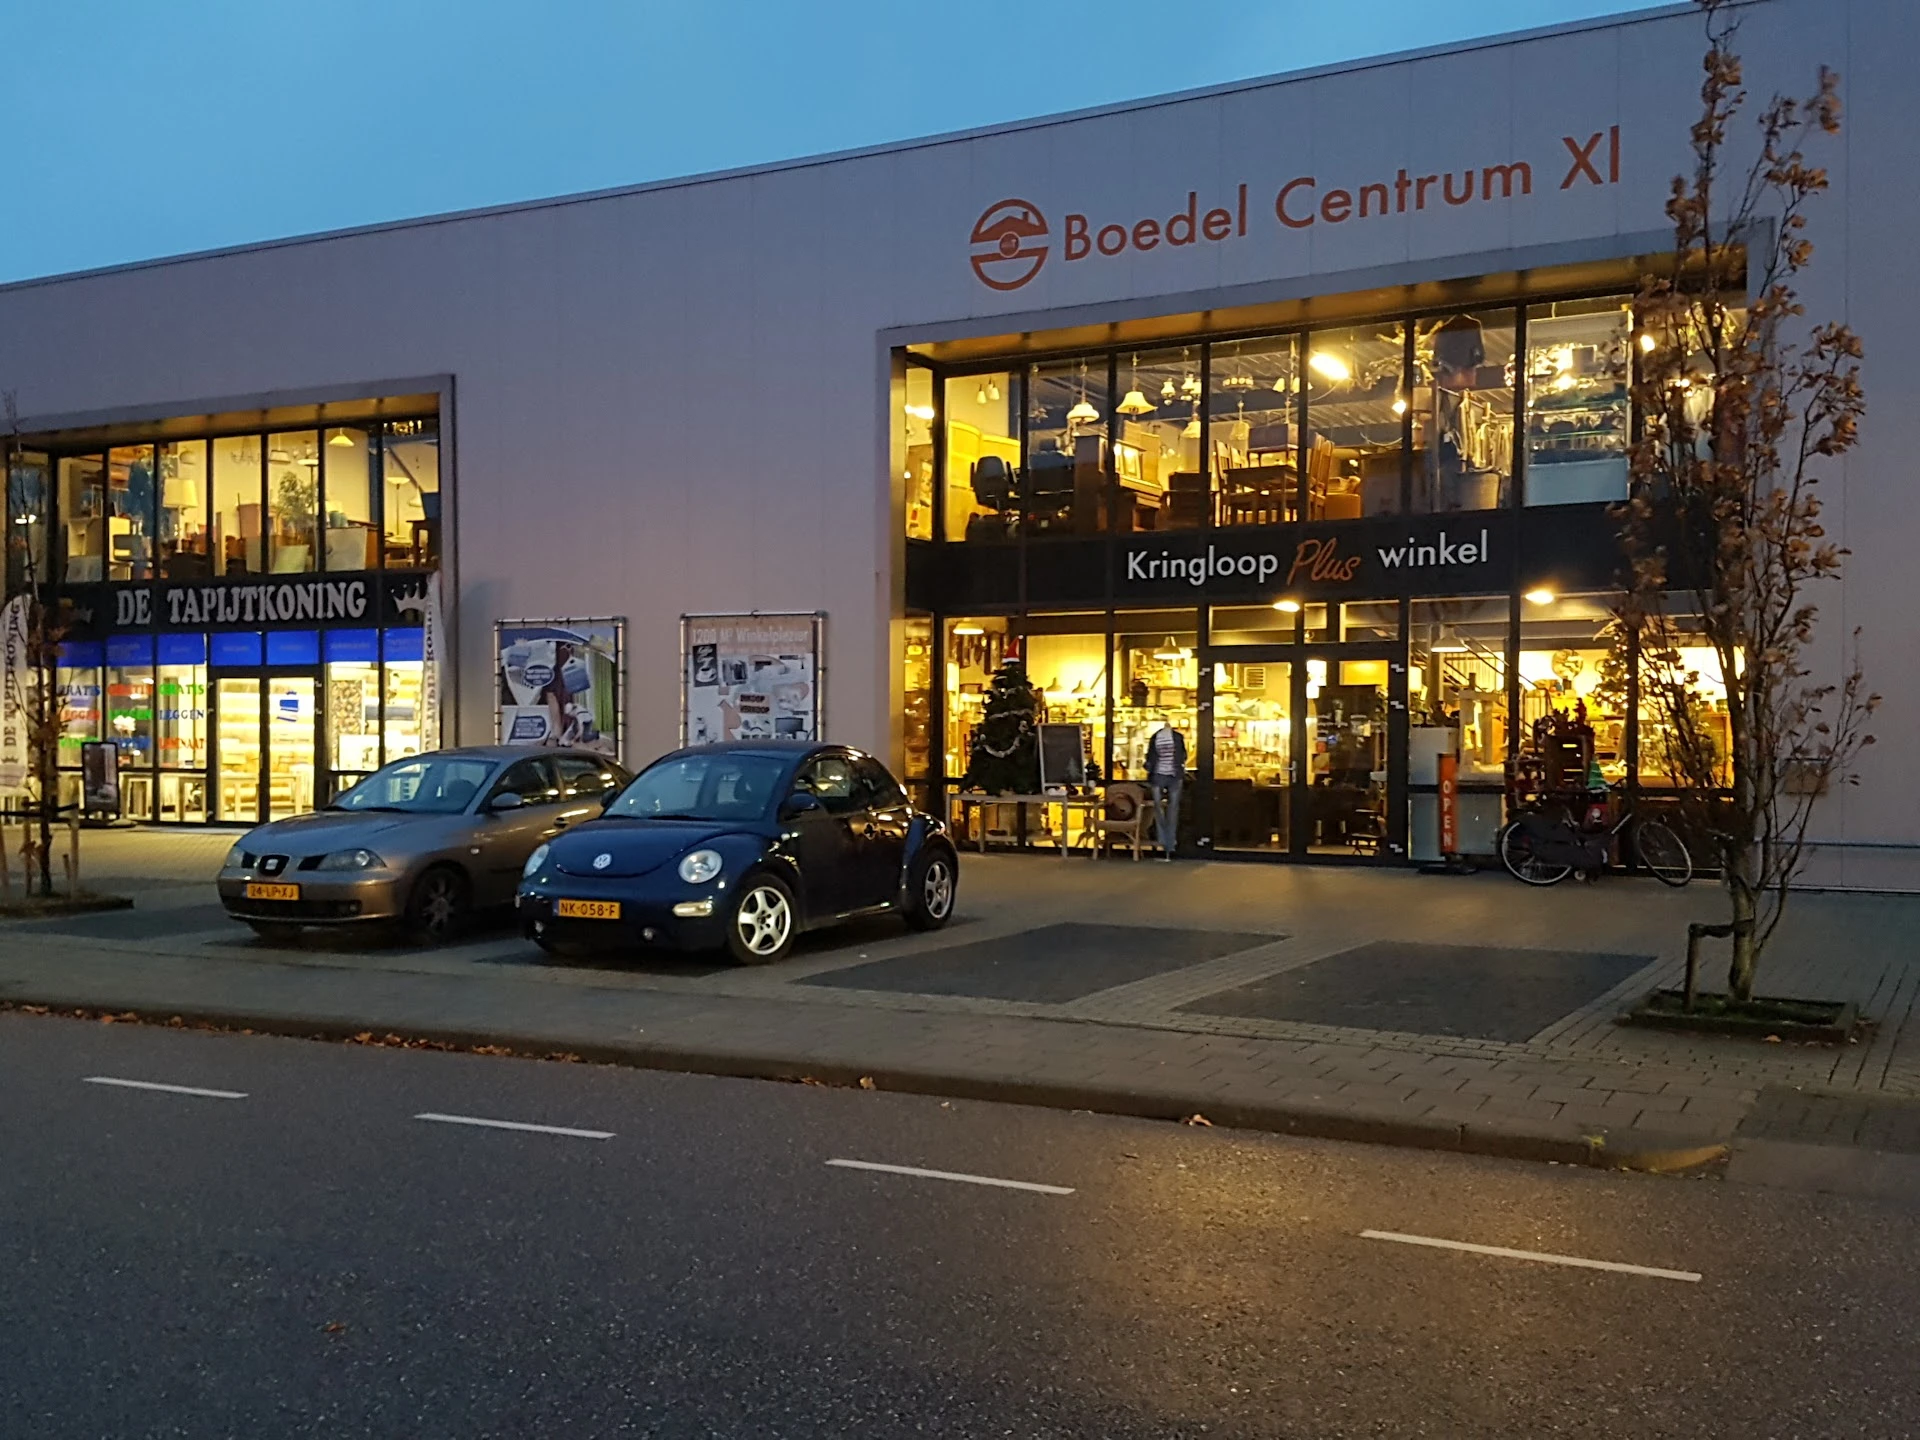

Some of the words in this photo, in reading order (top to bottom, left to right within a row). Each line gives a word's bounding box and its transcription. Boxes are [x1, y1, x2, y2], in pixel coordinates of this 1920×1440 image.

[1064, 183, 1247, 261] Boedel
[1274, 159, 1532, 230] Centrum
[1126, 542, 1279, 587] Kringloop
[1286, 538, 1363, 584] Plus
[1377, 529, 1490, 570] winkel
[116, 588, 152, 626] DE
[167, 581, 367, 623] TAPIJTKONING
[159, 709, 205, 721] LEGGEN
[1442, 780, 1453, 847] OPEN
[559, 902, 616, 917] NK-058-F
